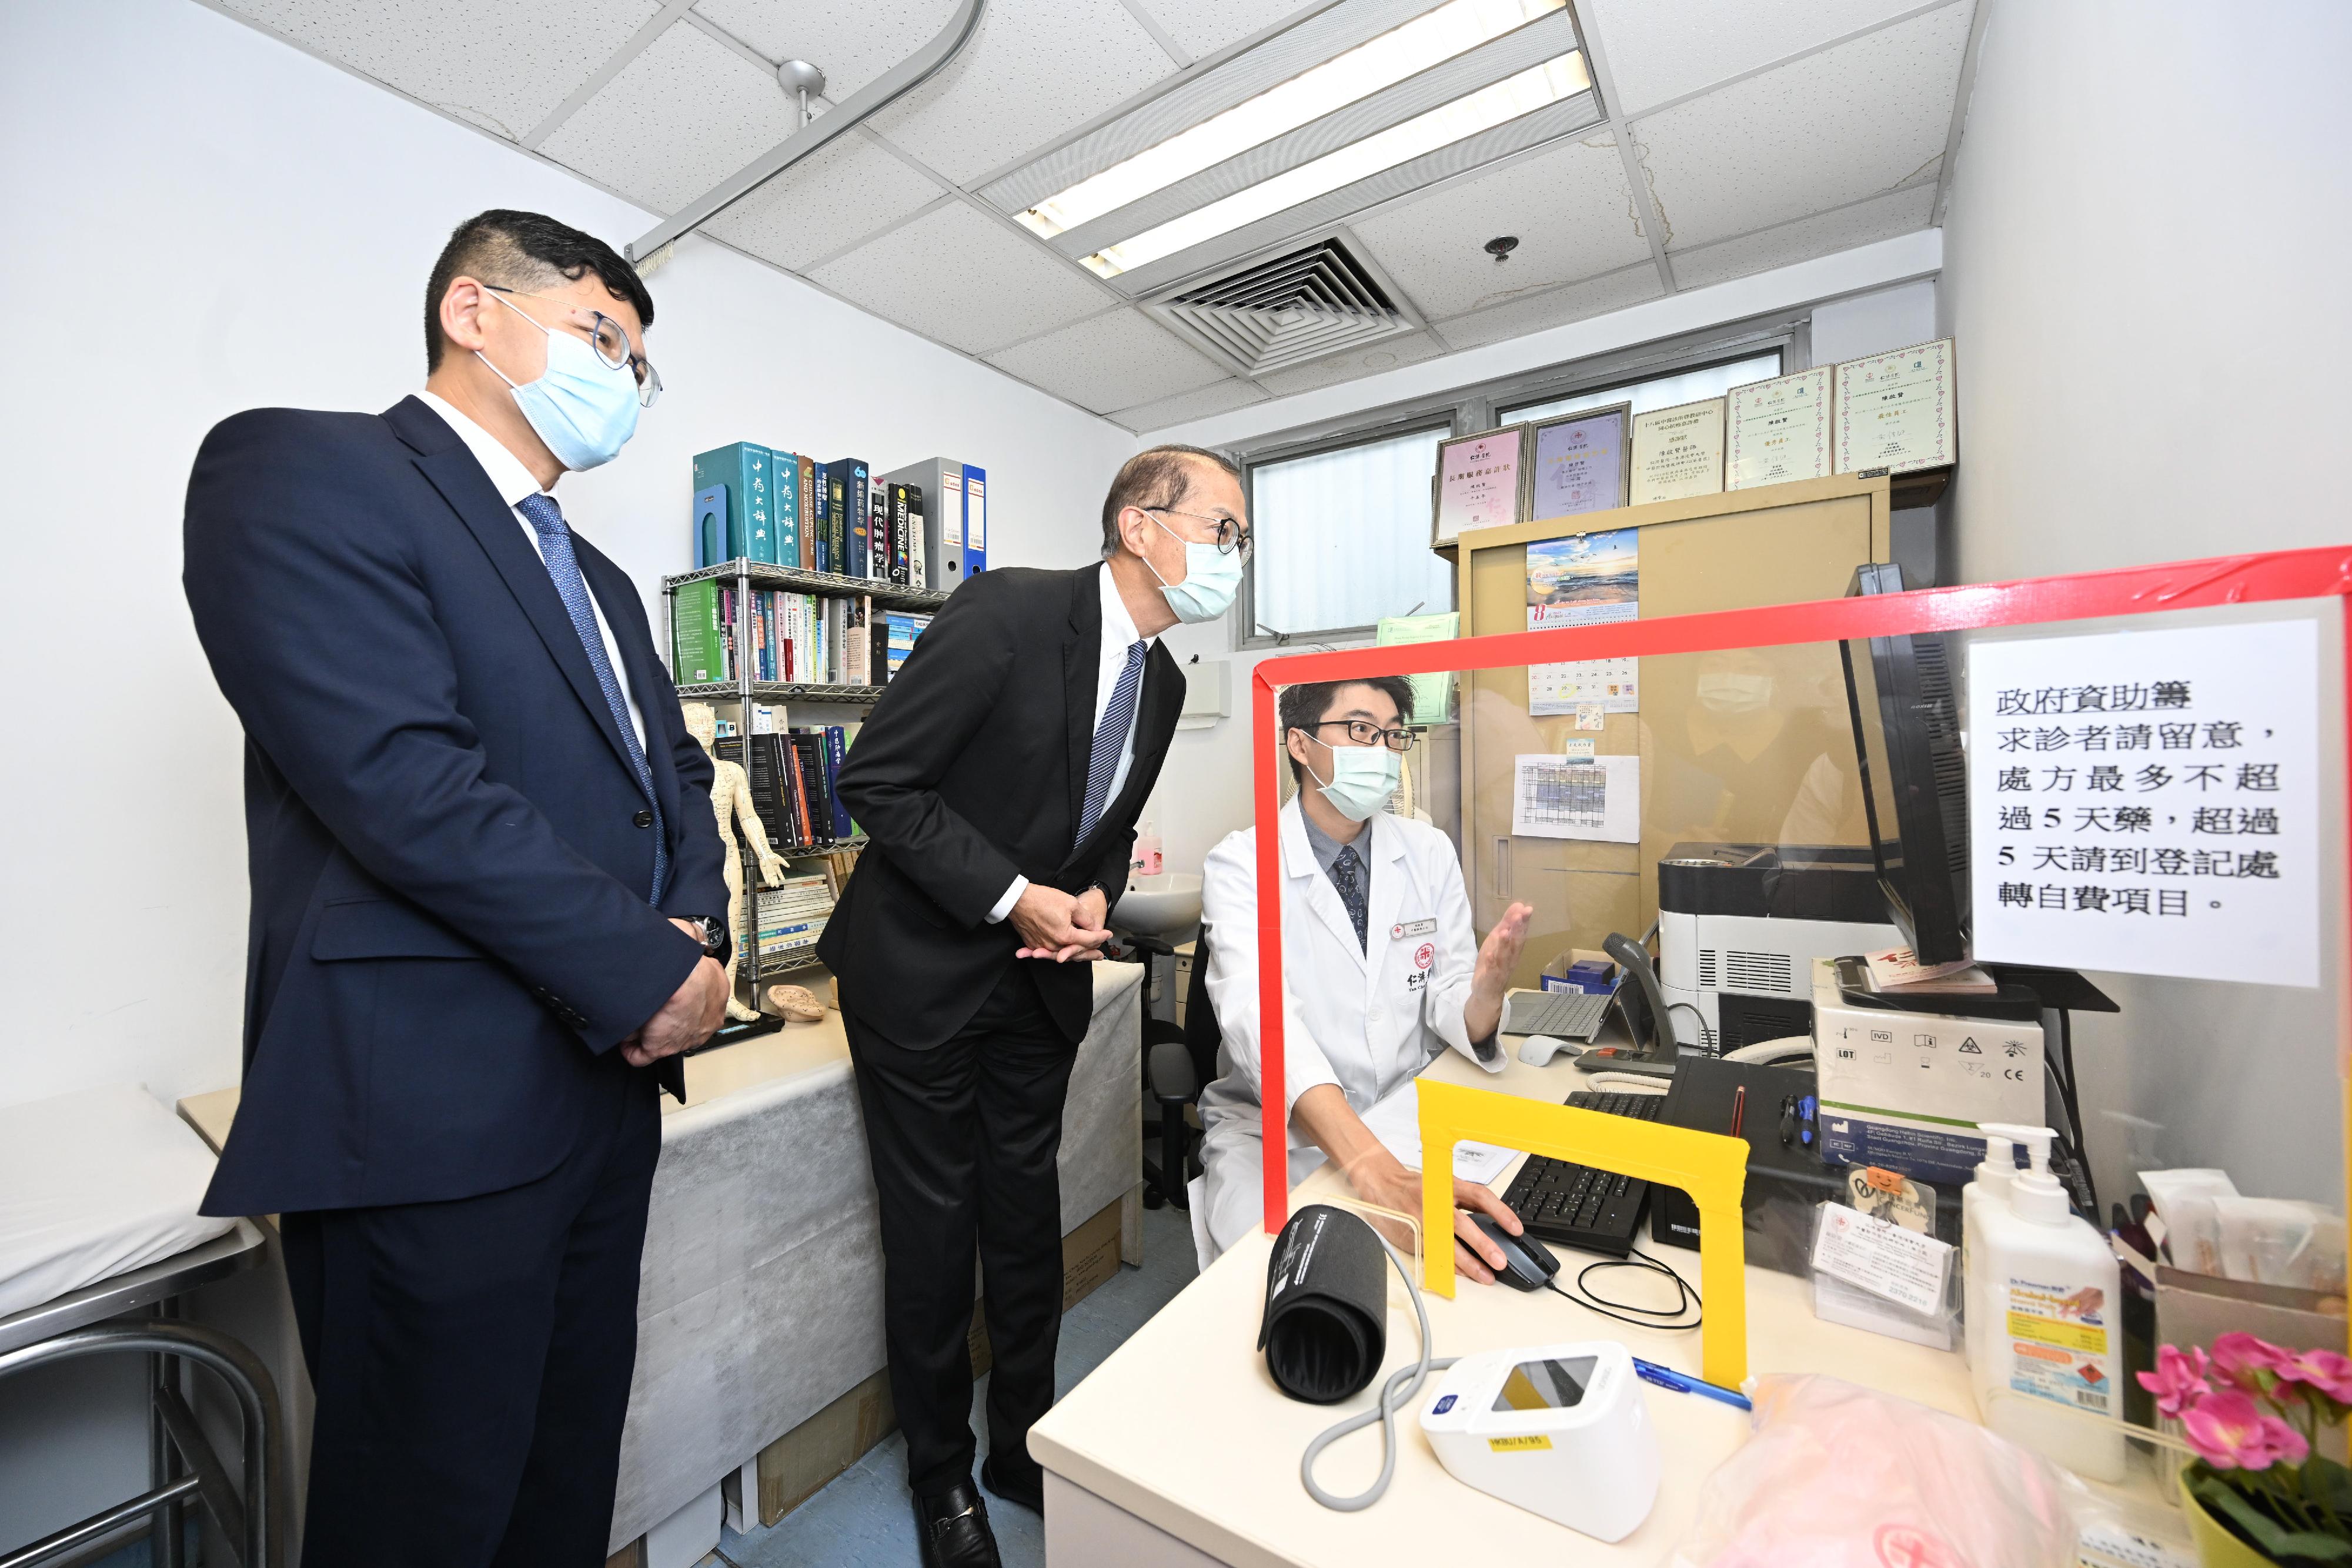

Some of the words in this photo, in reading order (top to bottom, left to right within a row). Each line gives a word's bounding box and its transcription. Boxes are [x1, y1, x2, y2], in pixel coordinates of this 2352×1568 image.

[1449, 464, 1511, 482] 長期服務嘉許狀
[753, 459, 767, 541] 中药大辞典
[781, 467, 794, 547] 中药大辞典
[857, 480, 865, 525] 新编药物学
[874, 504, 884, 563] 现代肿瘤学
[1534, 604, 1546, 621] 8
[1997, 681, 2191, 715] 政府資助籌
[1998, 721, 2274, 753] 求診者請留意，
[1997, 762, 2280, 793] 處方最多不超
[1999, 882, 2221, 917] 轉自費項目。
[1839, 1049, 1855, 1059] LOT
